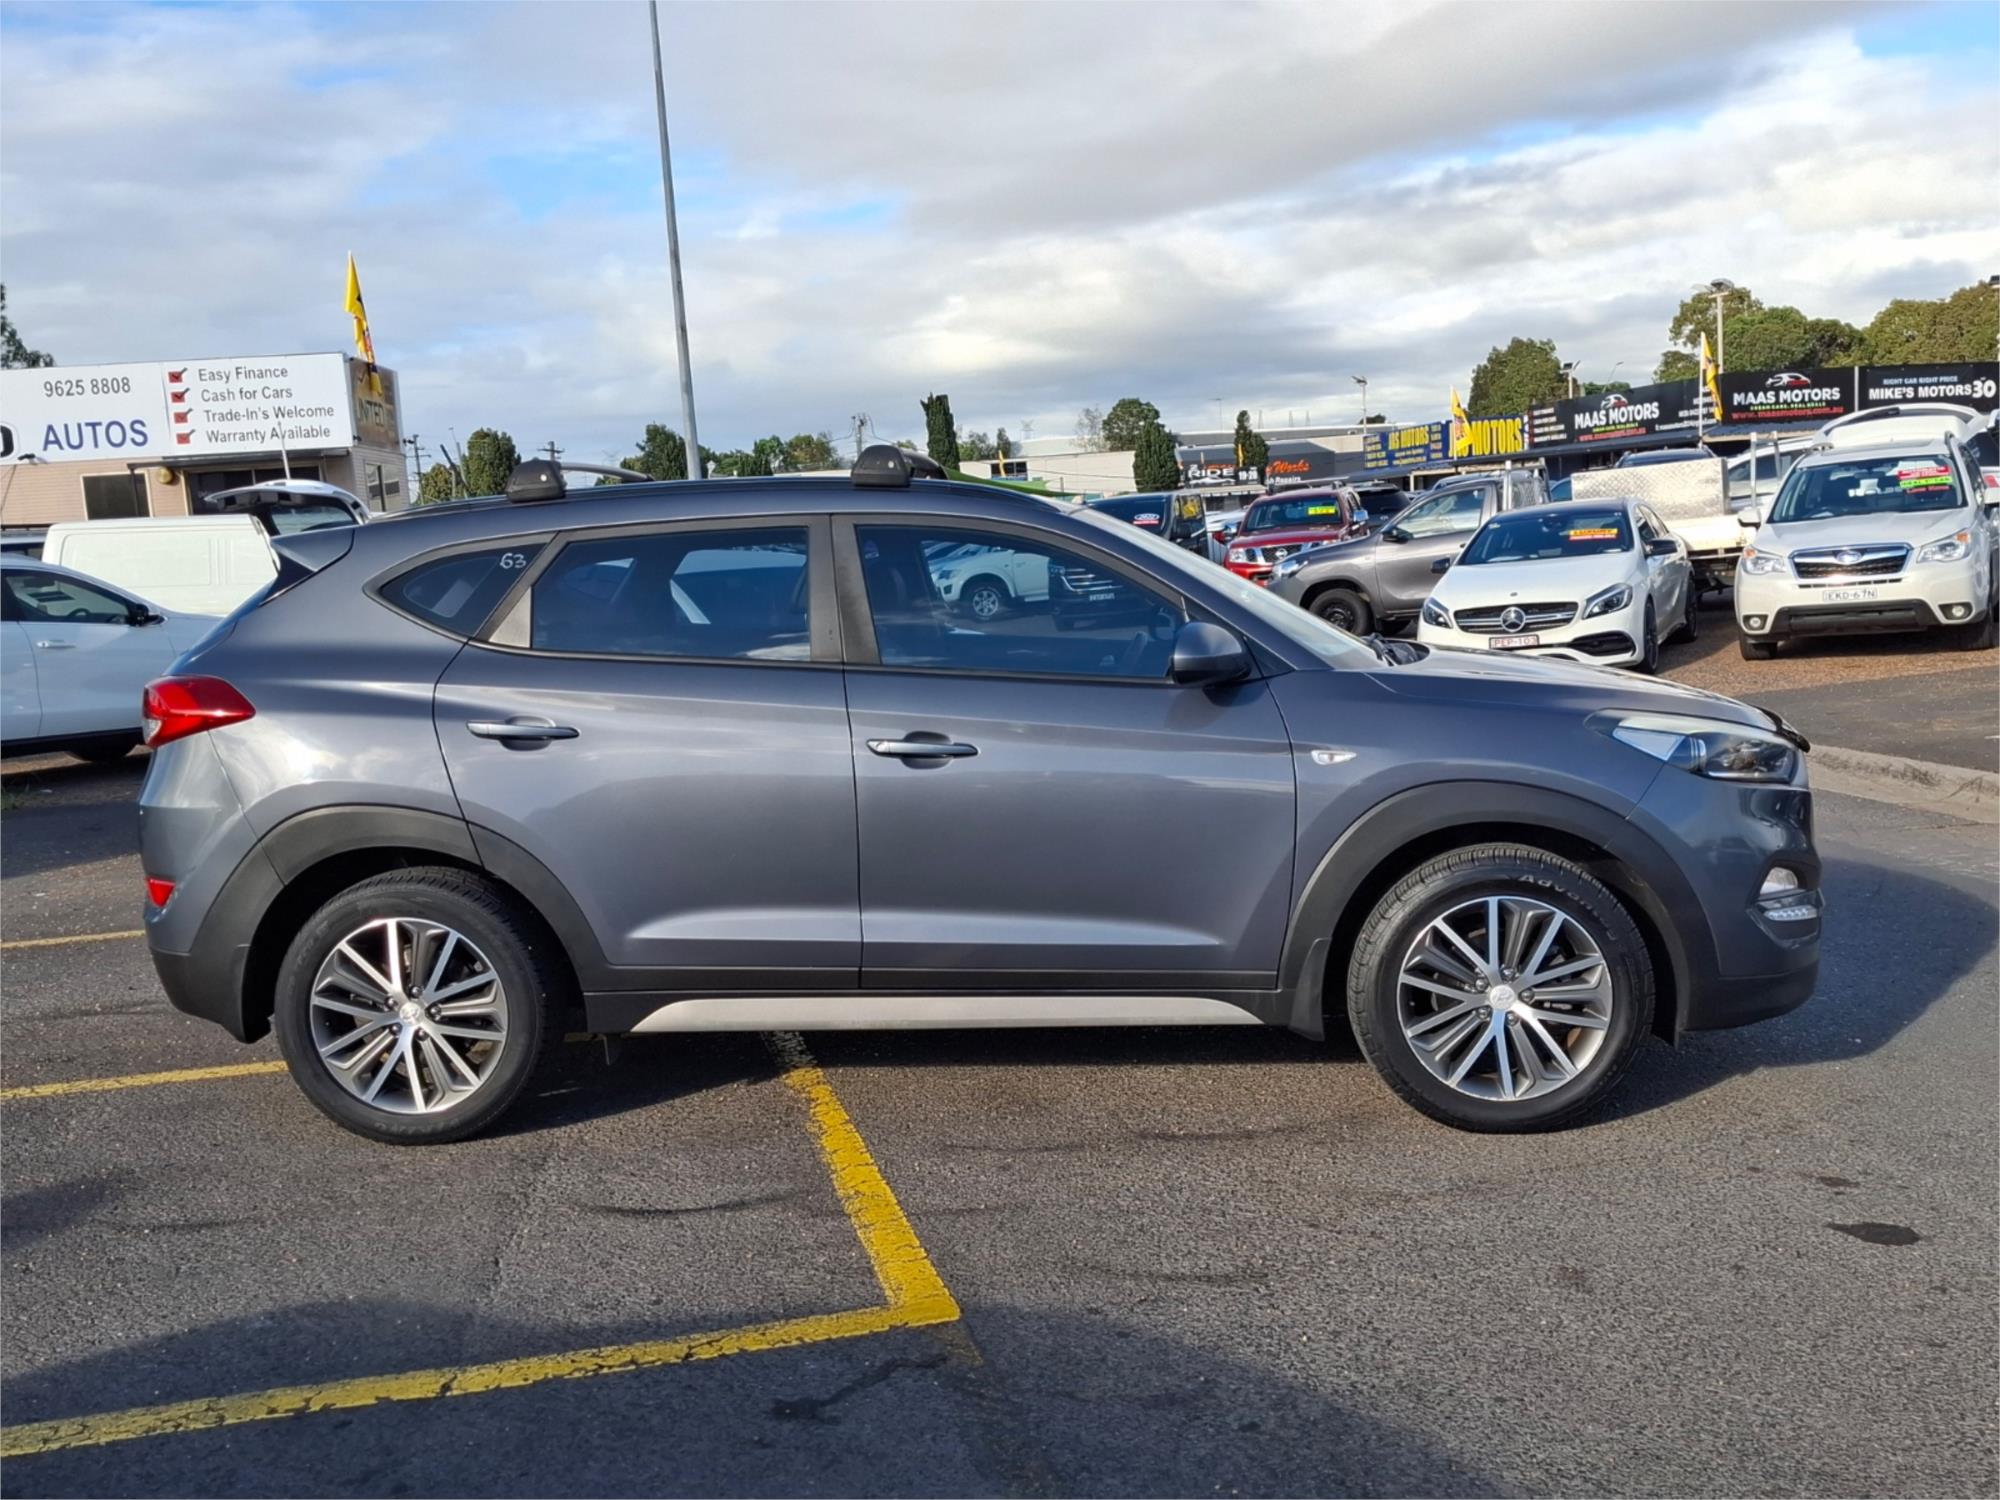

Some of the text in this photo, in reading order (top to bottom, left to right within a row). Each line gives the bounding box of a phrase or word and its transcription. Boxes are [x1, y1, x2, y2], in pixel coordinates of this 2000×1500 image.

[198, 366, 288, 384] Easy Finance
[44, 377, 131, 397] 9625 8808
[201, 386, 293, 402] Cash for Cars
[1869, 379, 1997, 400] MIKE'S MOTORS 30
[1733, 387, 1841, 406] MAAS MOTORS
[204, 405, 335, 423] Trade-In's Welcome
[1574, 409, 1607, 430] MAAS
[1609, 401, 1660, 425] MOTORS
[43, 419, 148, 451] AUTOS
[206, 426, 331, 444] Warranty Available
[1471, 418, 1522, 456] MOTORS
[1188, 467, 1235, 479] RIDE
[500, 552, 527, 569] 63
